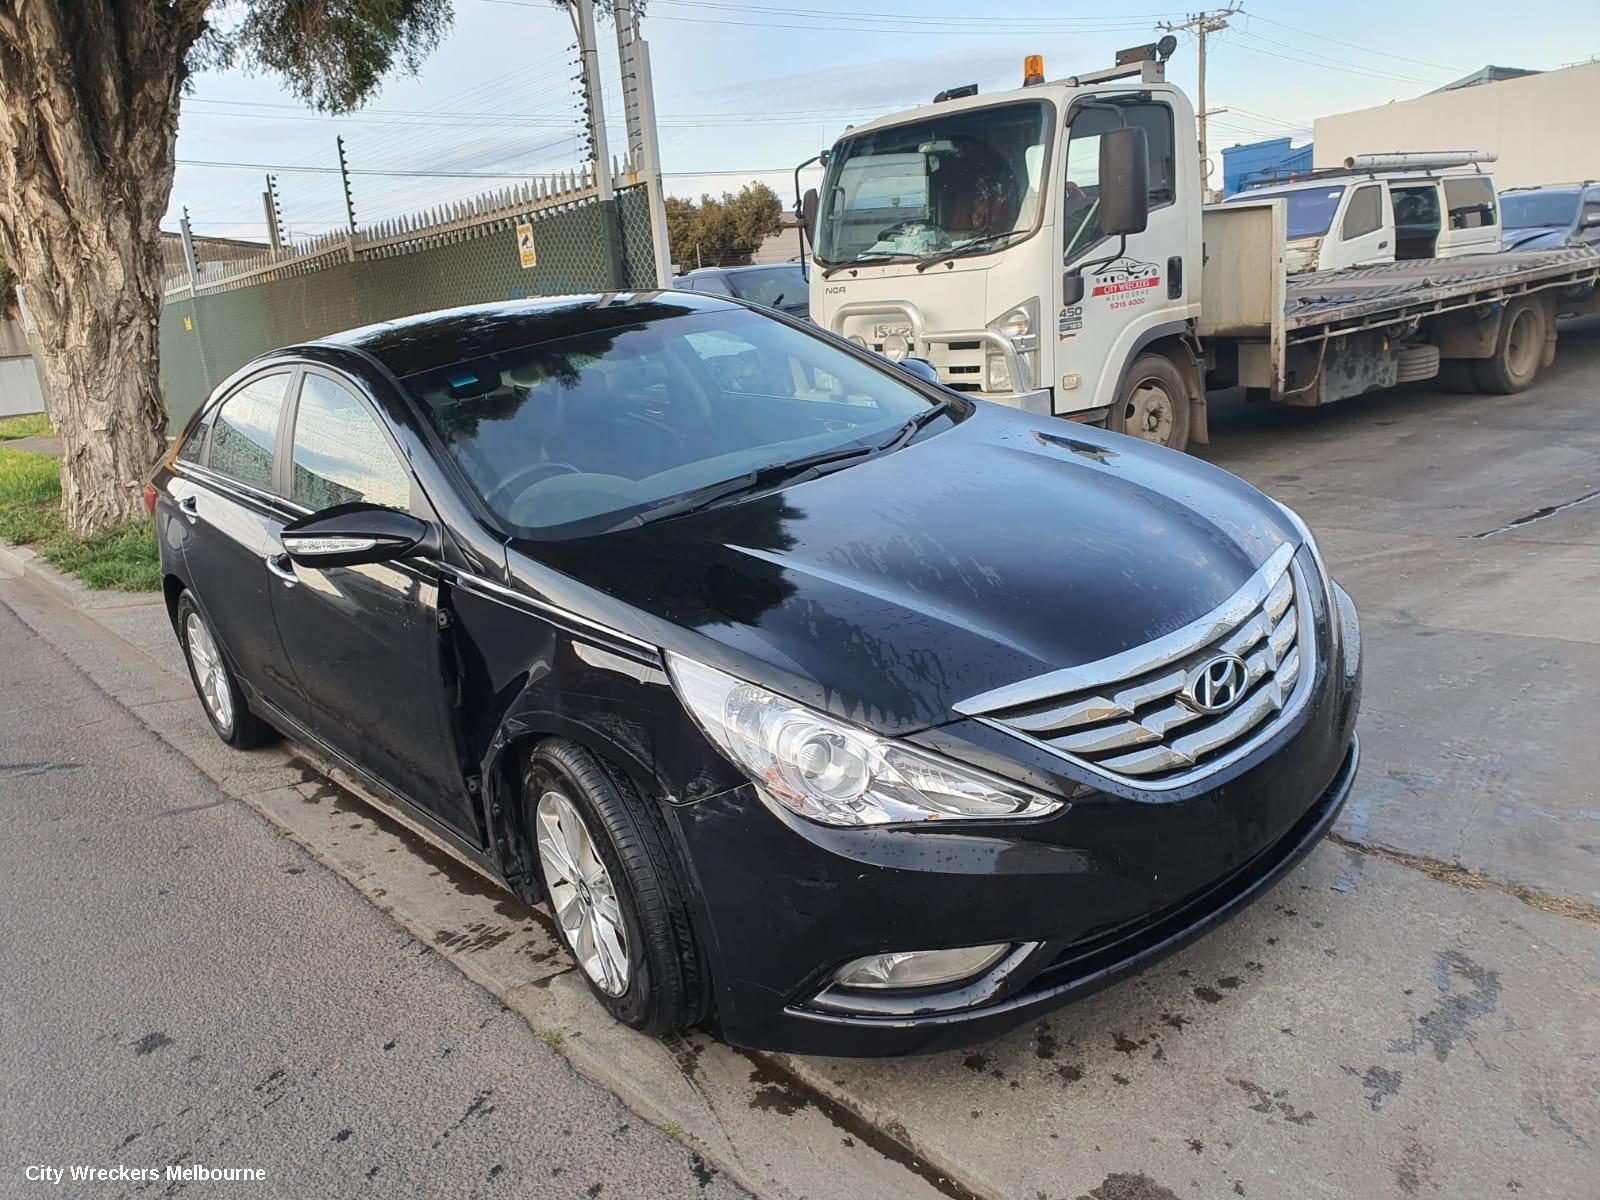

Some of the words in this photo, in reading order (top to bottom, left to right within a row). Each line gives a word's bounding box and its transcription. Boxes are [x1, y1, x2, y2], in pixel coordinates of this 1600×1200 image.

[1103, 284, 1119, 294] CITY
[1120, 280, 1150, 291] WRECKERS
[1105, 290, 1149, 301] MELBOURNE
[1109, 301, 1126, 309] 9315
[1128, 298, 1145, 306] 4000
[1059, 306, 1082, 318] 450
